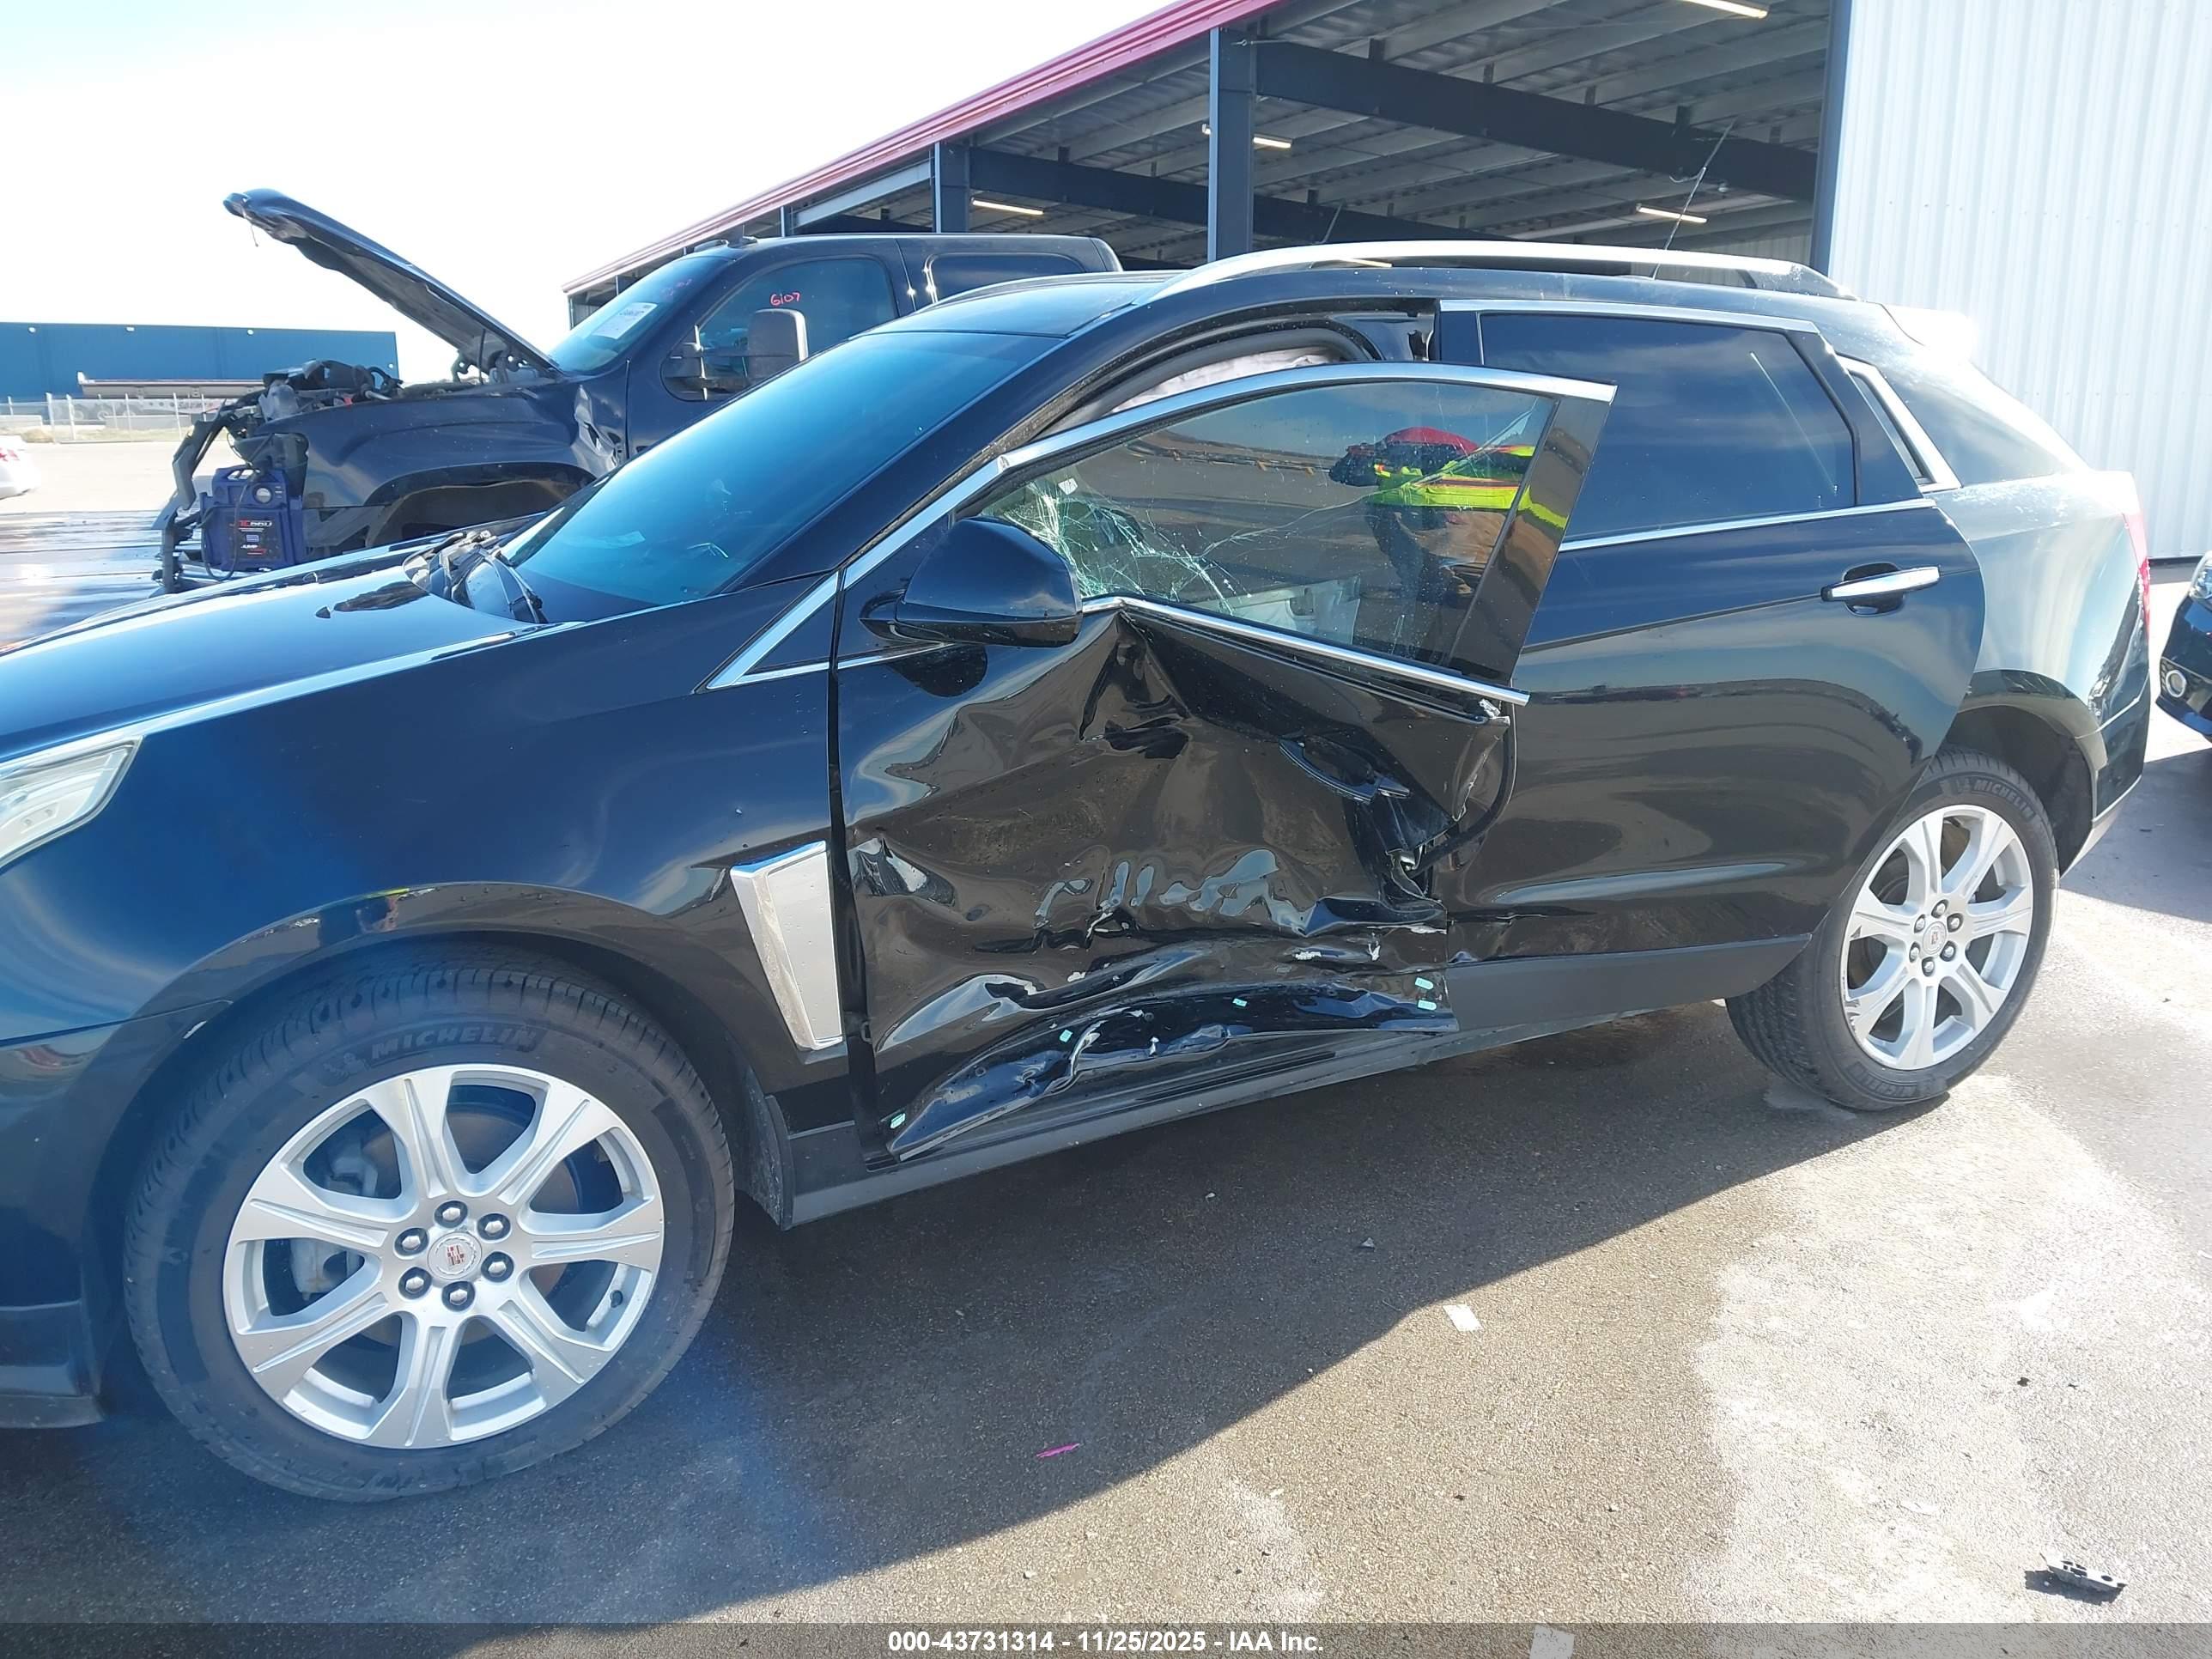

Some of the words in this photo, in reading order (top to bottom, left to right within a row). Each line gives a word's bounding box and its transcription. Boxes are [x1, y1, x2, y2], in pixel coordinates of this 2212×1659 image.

[770, 292, 800, 306] 6107
[1973, 778, 2035, 819] MICHELIN
[371, 1026, 538, 1060] MICHELIN
